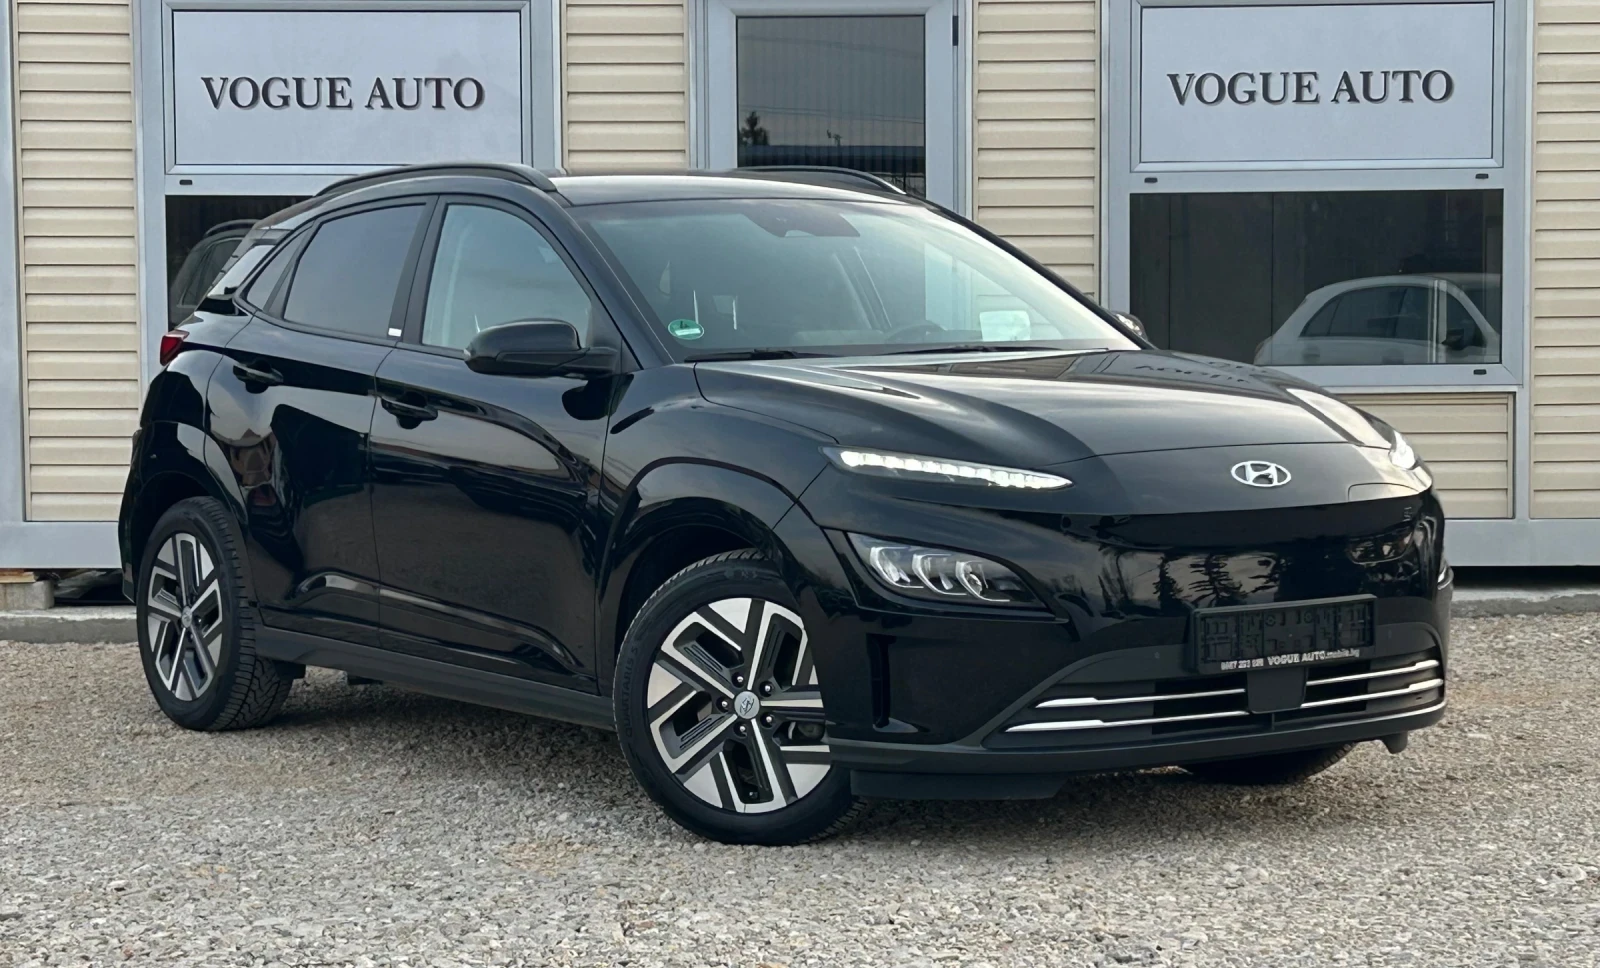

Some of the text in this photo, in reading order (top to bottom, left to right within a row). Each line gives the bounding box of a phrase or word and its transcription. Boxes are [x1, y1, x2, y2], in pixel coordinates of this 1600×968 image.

[201, 77, 485, 110] VOGUE AUTO
[1166, 69, 1454, 105] VOGUE AUTO
[1267, 653, 1300, 665] VOGUE
